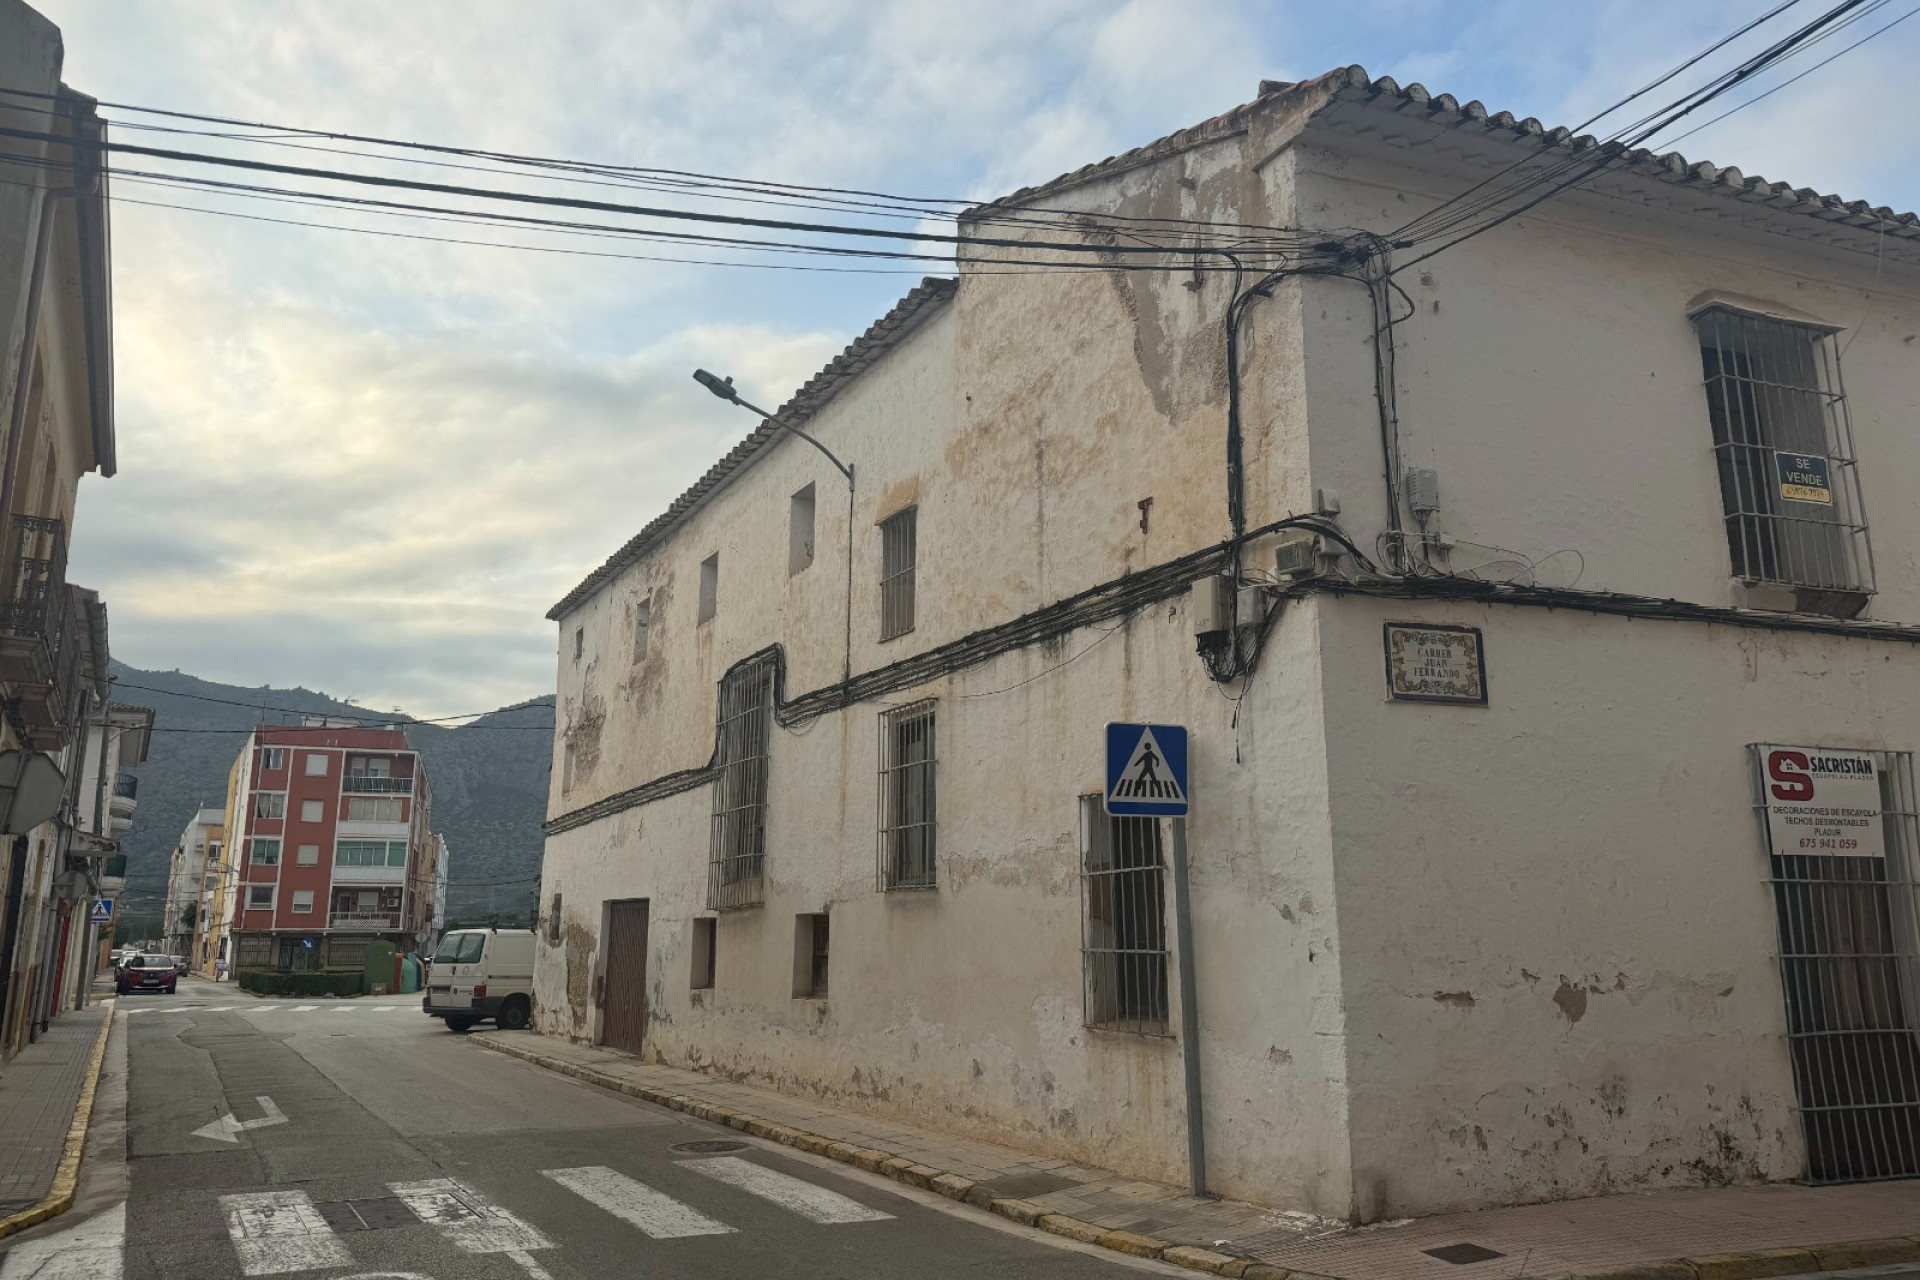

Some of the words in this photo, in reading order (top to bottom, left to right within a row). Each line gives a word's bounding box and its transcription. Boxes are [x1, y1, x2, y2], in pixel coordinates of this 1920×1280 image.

[1796, 458, 1811, 469] SE
[1786, 471, 1823, 486] VENDE
[1417, 647, 1452, 659] CARRER
[1424, 658, 1448, 667] JUAN
[1414, 667, 1460, 679] FERRANDO
[1810, 756, 1873, 774] SACRISTÁN
[1773, 806, 1829, 816] DECORACIONES
[1830, 808, 1840, 816] DE
[1841, 808, 1877, 817] ESCAYOLA
[1785, 817, 1813, 825] TECHOS
[1815, 818, 1869, 827] DESMONTABLES
[1814, 828, 1841, 836] PLADUR
[1799, 838, 1816, 848] 675
[1819, 838, 1836, 849] 941
[1839, 839, 1857, 849] 059
